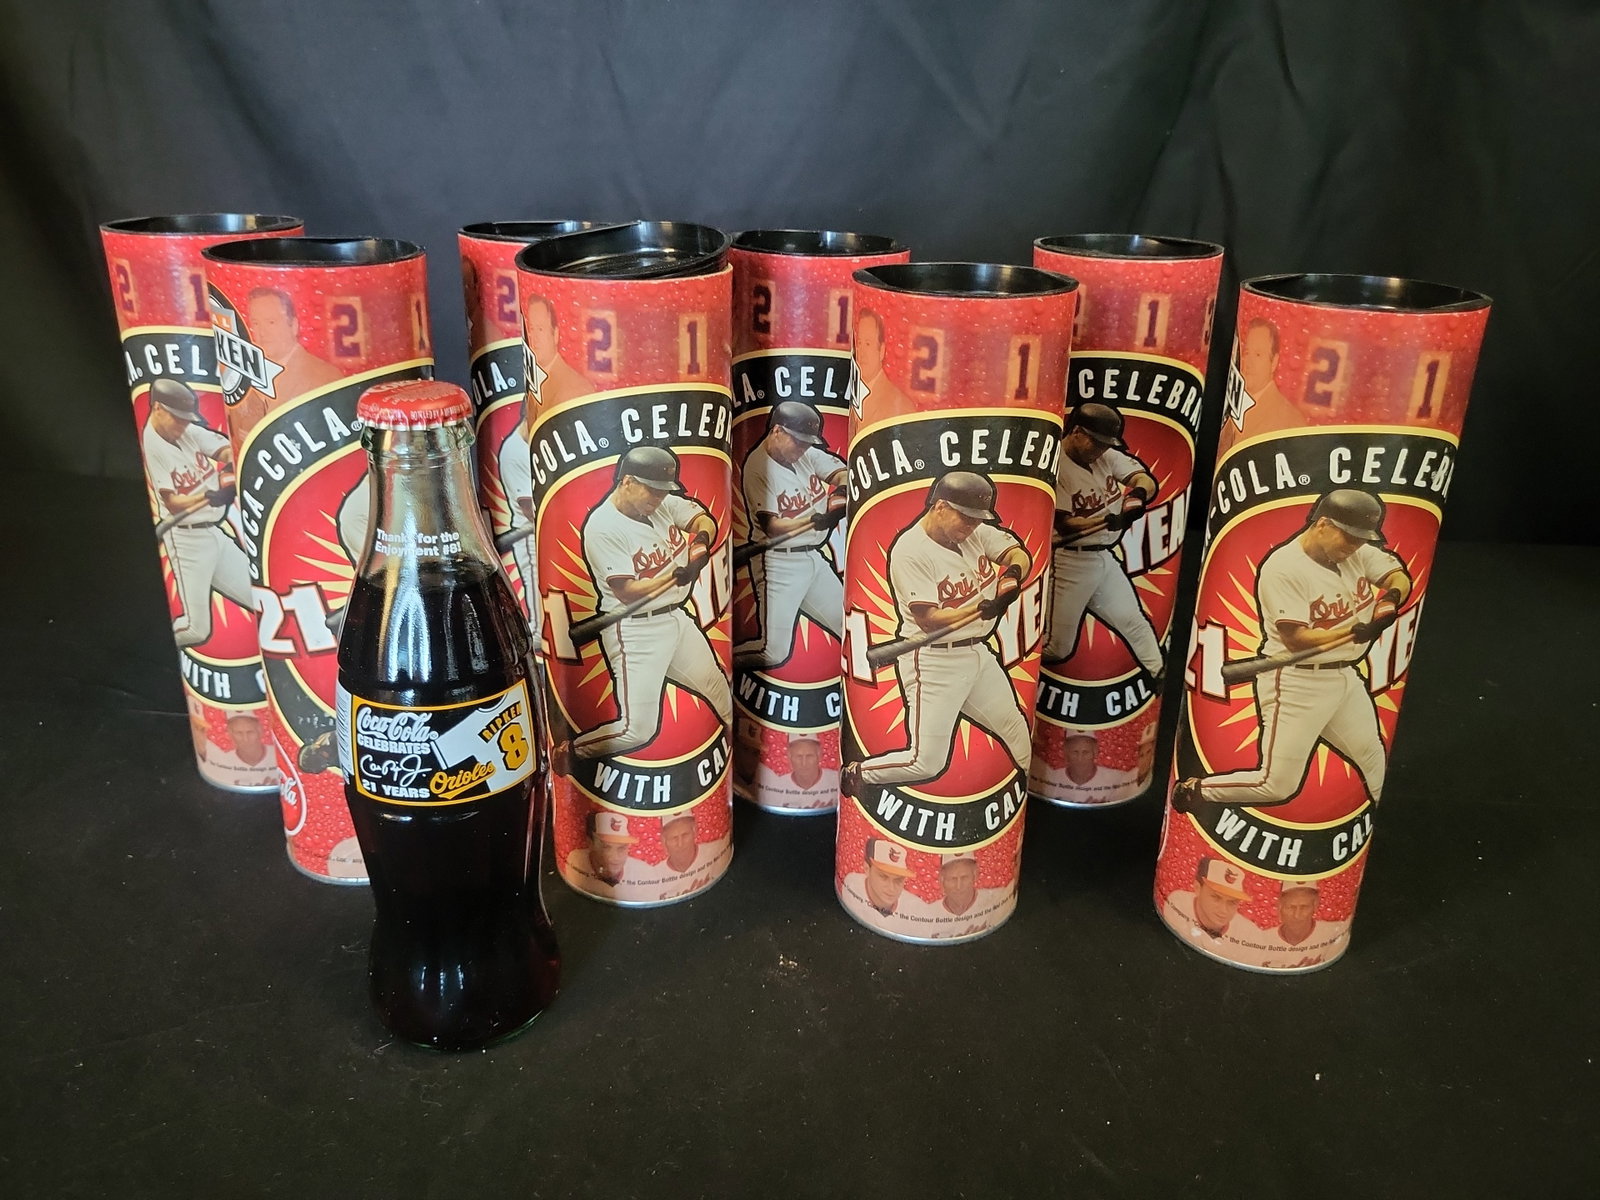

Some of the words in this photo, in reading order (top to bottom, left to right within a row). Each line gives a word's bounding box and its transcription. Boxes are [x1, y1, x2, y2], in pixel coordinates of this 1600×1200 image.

[144, 344, 220, 378] CEL
[585, 316, 613, 374] 2
[686, 319, 702, 376] 1
[909, 334, 940, 394] 2
[1014, 342, 1031, 401] 1
[774, 365, 851, 401] CEL
[1305, 346, 1340, 407] 2
[1416, 358, 1440, 420] 1
[416, 533, 438, 545] for
[440, 531, 460, 545] the
[250, 577, 338, 654] 21
[543, 590, 578, 660] 1
[841, 610, 874, 684] 1
[181, 650, 231, 699] WITH
[740, 673, 799, 721] WITH
[1105, 679, 1151, 716] CAL
[357, 732, 431, 755] CELEBRATES
[497, 721, 530, 771] 8
[362, 779, 377, 793] 21
[382, 784, 430, 799] YEARS
[429, 760, 496, 800] Orioles
[594, 762, 671, 804] WITH
[876, 787, 956, 842] WITH
[984, 780, 1027, 832] CAL
[1214, 807, 1302, 869] WITH
[1331, 811, 1374, 862] CAL
